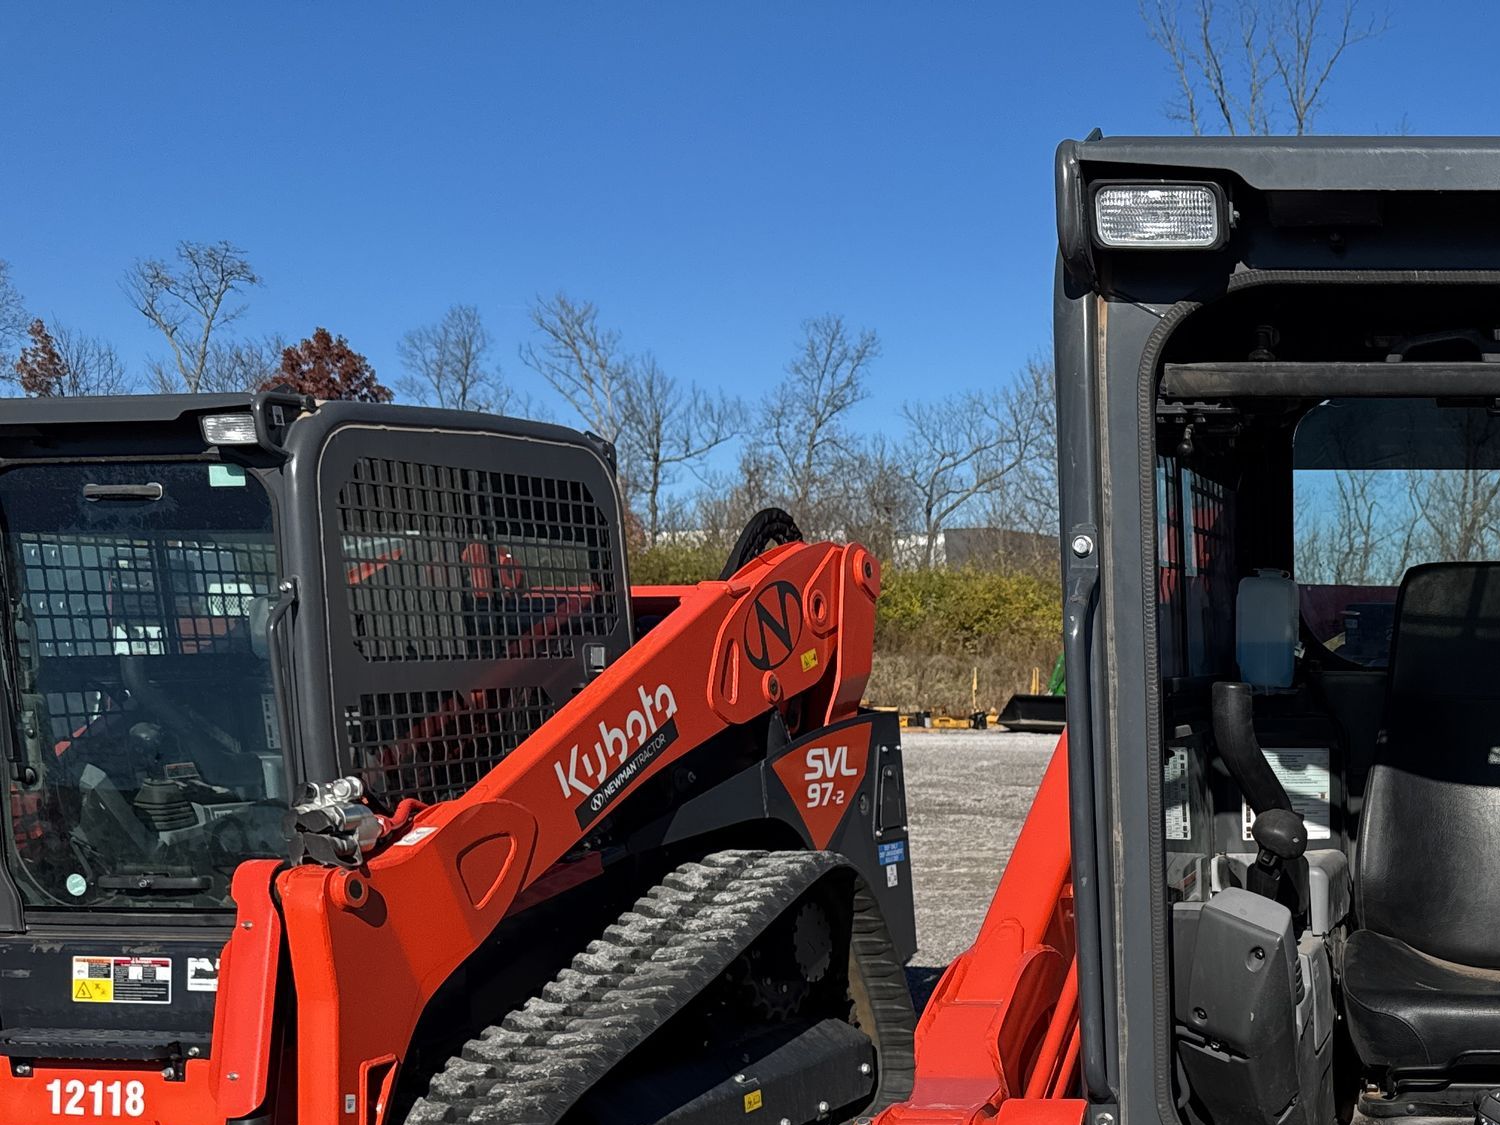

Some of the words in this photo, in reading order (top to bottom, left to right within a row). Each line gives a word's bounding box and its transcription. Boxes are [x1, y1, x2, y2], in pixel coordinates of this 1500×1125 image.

[553, 683, 678, 799] Kubota
[804, 745, 857, 781] SVL
[46, 1078, 145, 1117] 12118
